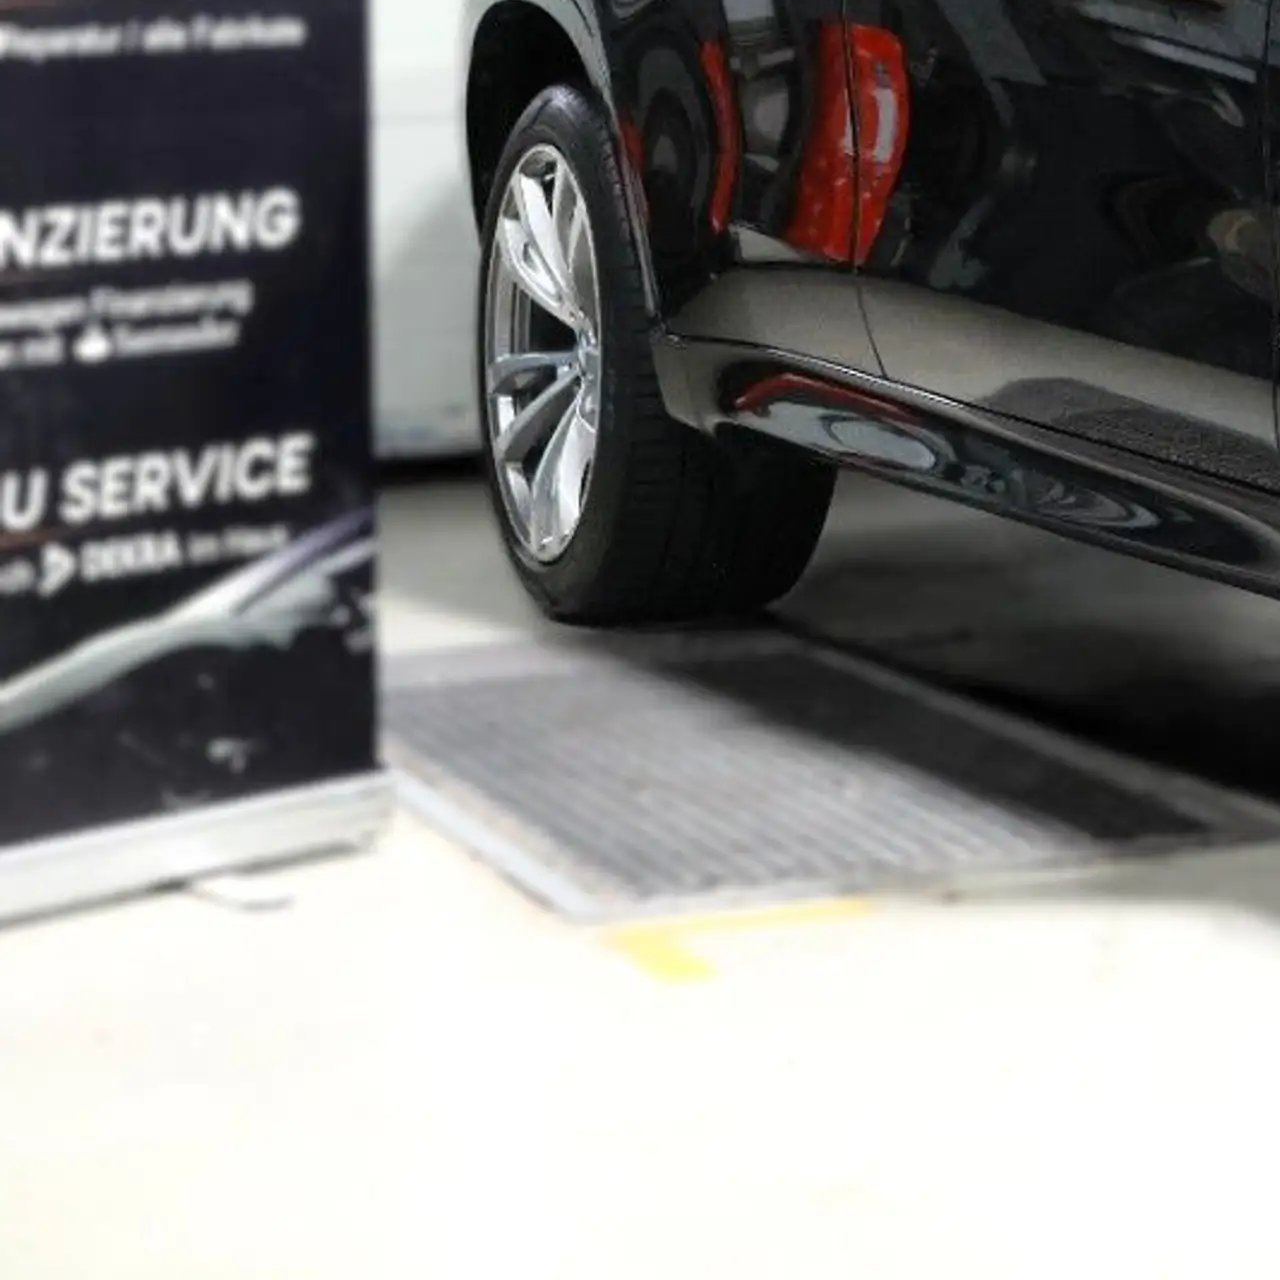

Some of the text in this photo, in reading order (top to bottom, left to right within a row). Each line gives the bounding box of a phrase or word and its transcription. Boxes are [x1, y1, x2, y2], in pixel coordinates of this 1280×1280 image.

[0, 187, 301, 270] NZIERUNG
[60, 432, 314, 525] SERVICE
[79, 531, 183, 582] DEKRA
